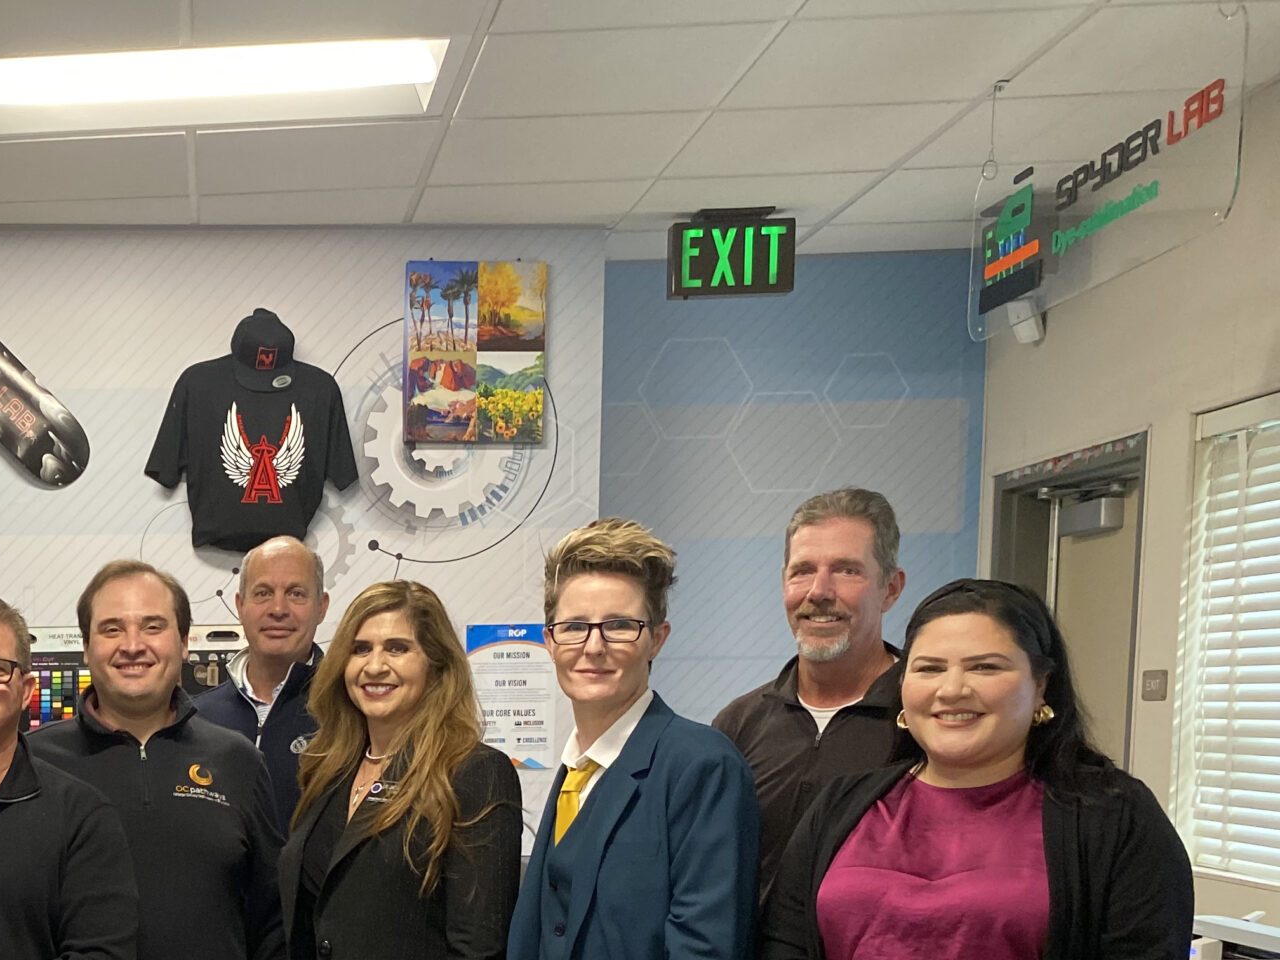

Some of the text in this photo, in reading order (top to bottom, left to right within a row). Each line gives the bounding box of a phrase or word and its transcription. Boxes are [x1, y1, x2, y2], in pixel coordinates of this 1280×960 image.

[1055, 78, 1226, 212] SPYDER LAB
[681, 225, 787, 288] EXIT
[508, 628, 527, 638] ROP
[506, 651, 531, 659] MISSION
[507, 679, 528, 687] VISION
[1145, 679, 1160, 691] EXIT
[483, 708, 536, 717] OUR CORE VALUES
